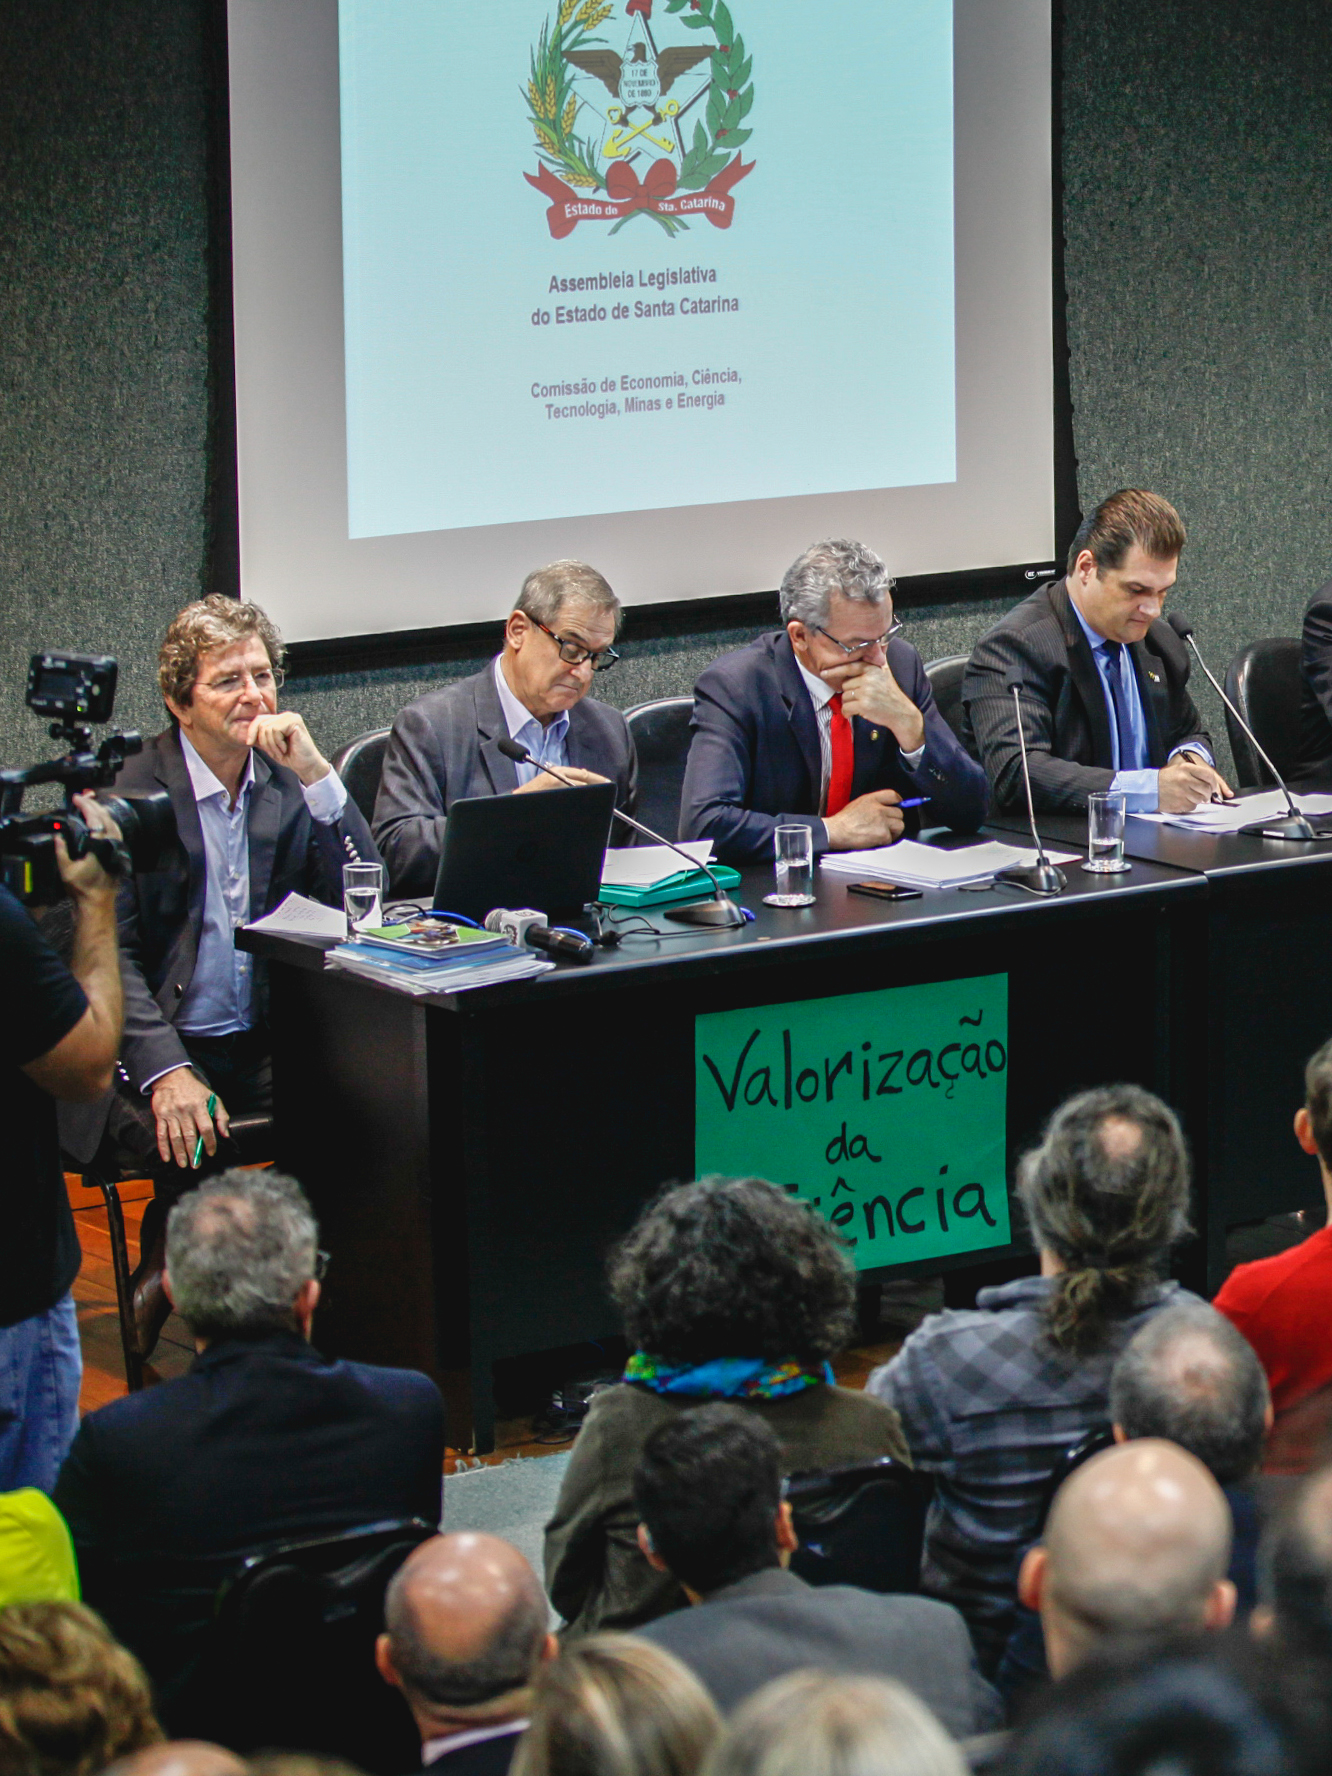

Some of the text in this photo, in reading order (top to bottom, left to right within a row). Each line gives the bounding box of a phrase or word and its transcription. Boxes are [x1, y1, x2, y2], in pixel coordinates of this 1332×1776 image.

[564, 202, 602, 218] Estado
[658, 196, 726, 212] Sta. Catarina
[548, 266, 717, 293] Assembleia Legislativa
[531, 295, 739, 326] do Estado de Santa Catarina
[530, 367, 742, 398] Comissão de Economia, Ciência,
[544, 391, 726, 420] Tecnologia, Minas e Energia
[703, 1009, 1007, 1113] Valorização
[825, 1121, 882, 1165] da
[785, 1164, 997, 1248] ência
